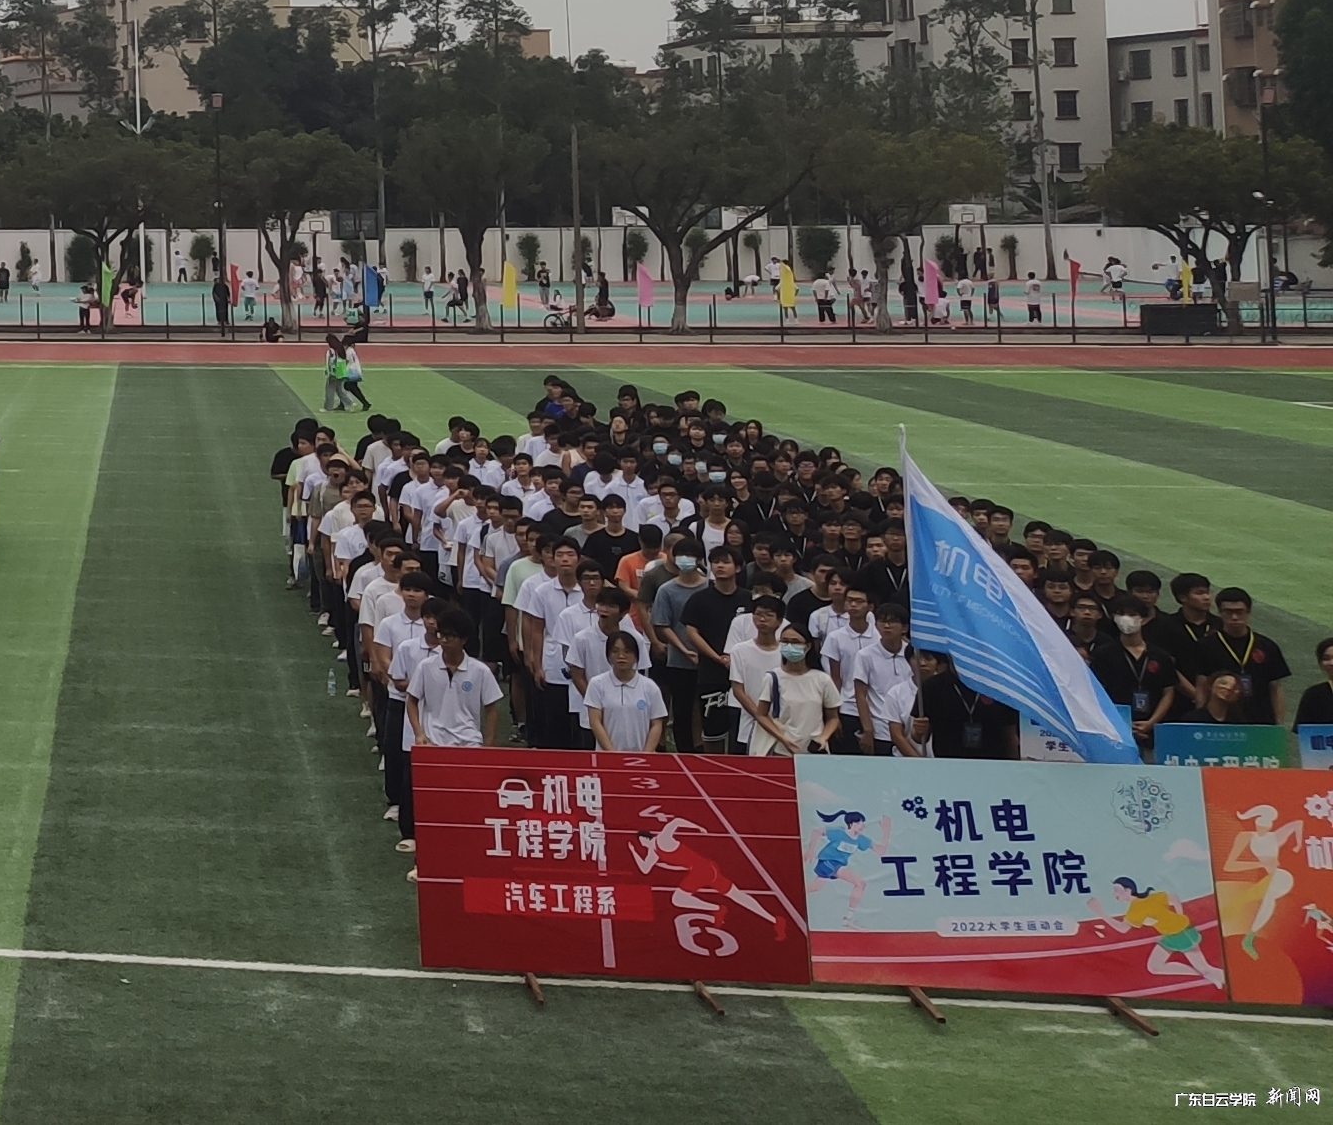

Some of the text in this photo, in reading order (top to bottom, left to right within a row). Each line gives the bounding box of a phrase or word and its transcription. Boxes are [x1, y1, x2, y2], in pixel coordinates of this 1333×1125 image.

[541, 774, 603, 817] 机电
[483, 817, 608, 862] 工程学院
[934, 797, 1036, 844] 机电
[880, 849, 1093, 897] 工程学院
[504, 881, 618, 916] 汽车工程系
[950, 918, 1065, 934] 2022大学生运动会
